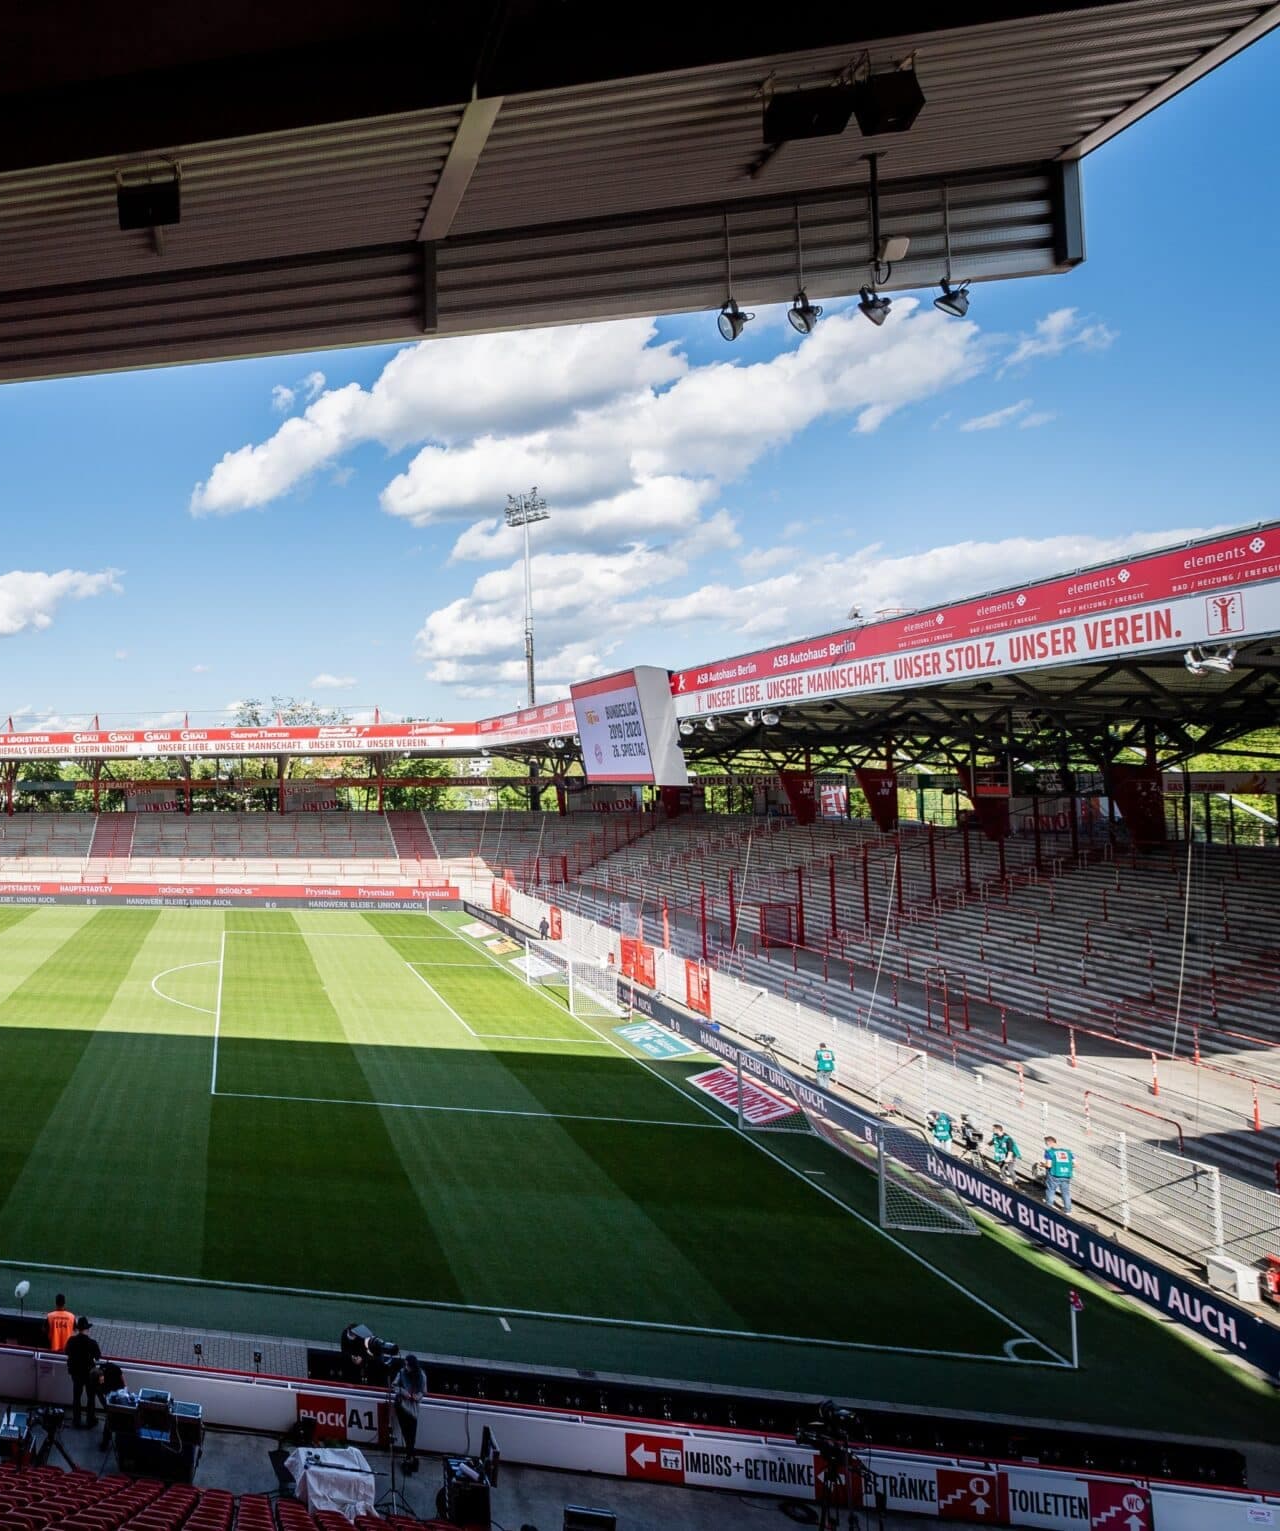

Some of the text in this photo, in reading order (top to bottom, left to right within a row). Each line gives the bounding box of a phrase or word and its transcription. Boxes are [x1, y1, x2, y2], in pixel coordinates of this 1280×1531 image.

[1184, 546, 1246, 569] elements
[1067, 578, 1115, 595] elements
[1172, 564, 1280, 592] BAD HEIZUNG ENERGI
[976, 601, 1014, 616] elements
[1078, 600, 1107, 611] HEIZUNG
[1115, 593, 1144, 604] ENERGIE
[904, 620, 935, 633] elements
[985, 621, 1008, 631] HEIZUNG
[1014, 615, 1037, 625] ENERGIE
[707, 608, 1182, 709] UNSERE LIEBE. UNSERE MANNSCHAFT. UNSER STOLZ. UNSER VEREIN.
[773, 640, 855, 668] ASB Autohaus Berlin
[697, 663, 756, 685] ASB Autohaus Berlin
[605, 701, 638, 720] BUNDESLIGA
[609, 720, 642, 742] 2019/2020
[75, 745, 100, 753] EISERN
[622, 742, 646, 757] SPIELTAG
[145, 800, 178, 812] UNION
[303, 800, 337, 811] UNION
[592, 798, 635, 812] UNION
[306, 888, 340, 896] Prysmian
[358, 888, 394, 897] Prysmian
[413, 889, 449, 897] Prysmian
[700, 1030, 739, 1060] HANDWERK
[799, 1087, 827, 1113] AUCH.
[695, 1068, 784, 1120] WOOLWORTH
[927, 1153, 1247, 1351] HANDWERK BLEIBT. UNION AUCH.
[348, 1409, 377, 1431] A1
[863, 1472, 936, 1502] GETRÄNKE
[1010, 1489, 1088, 1520] TOILETTEN
[1126, 1497, 1142, 1511] WC
